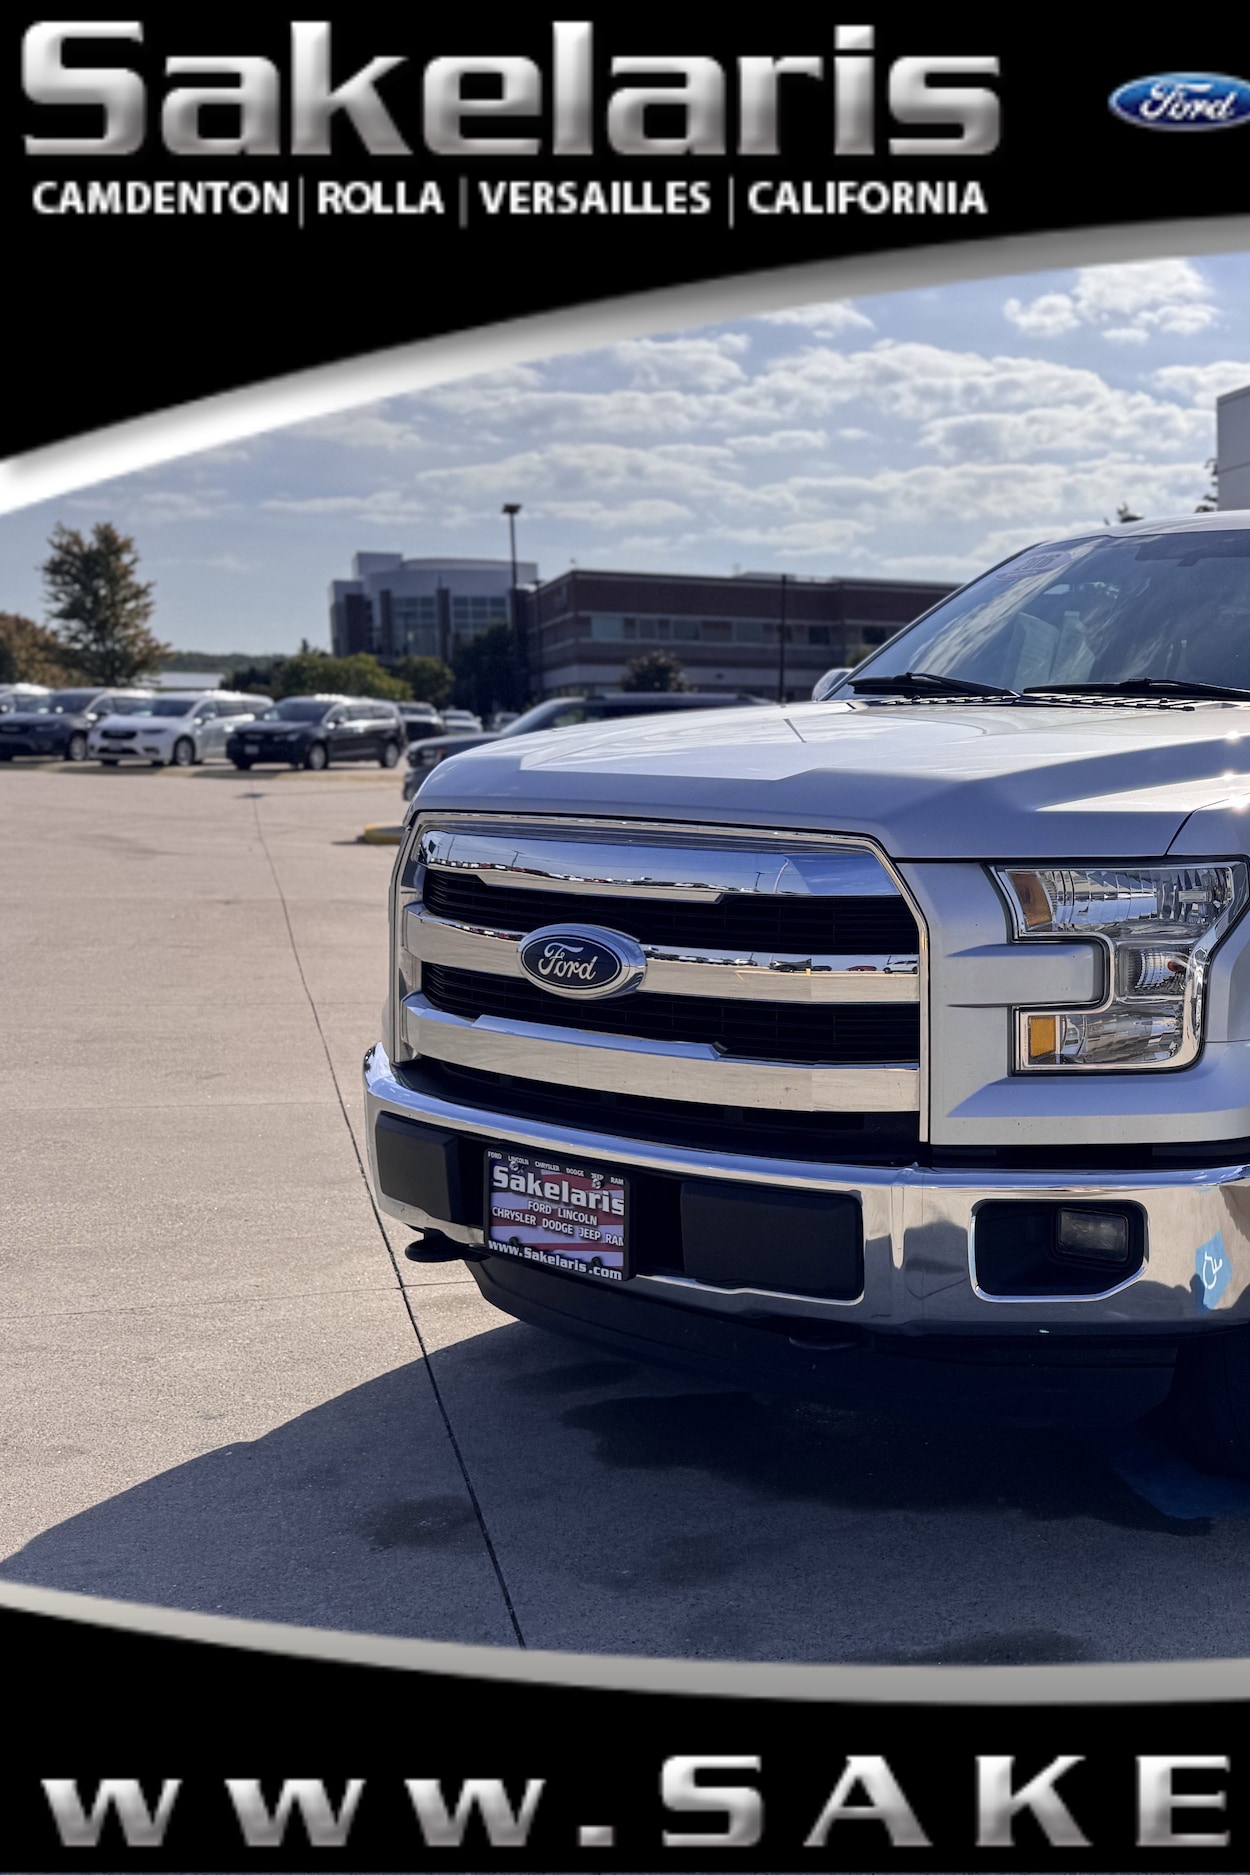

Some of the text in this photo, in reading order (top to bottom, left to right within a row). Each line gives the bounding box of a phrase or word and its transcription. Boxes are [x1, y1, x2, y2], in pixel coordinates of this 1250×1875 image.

[538, 942, 598, 980] Ford
[487, 1151, 502, 1160] FORD
[508, 1156, 529, 1165] LINCOLN
[535, 1161, 560, 1172] CHRYSLER
[566, 1167, 584, 1177] DODGE
[610, 1177, 624, 1185] RAM
[493, 1165, 625, 1216] Sakelaris
[492, 1206, 537, 1226] CHRYSLER
[542, 1217, 573, 1235] DODGE
[579, 1227, 601, 1241] JEEP
[528, 1200, 598, 1226] FORD LINCOLN
[488, 1239, 623, 1281] www.Sakelaris.com
